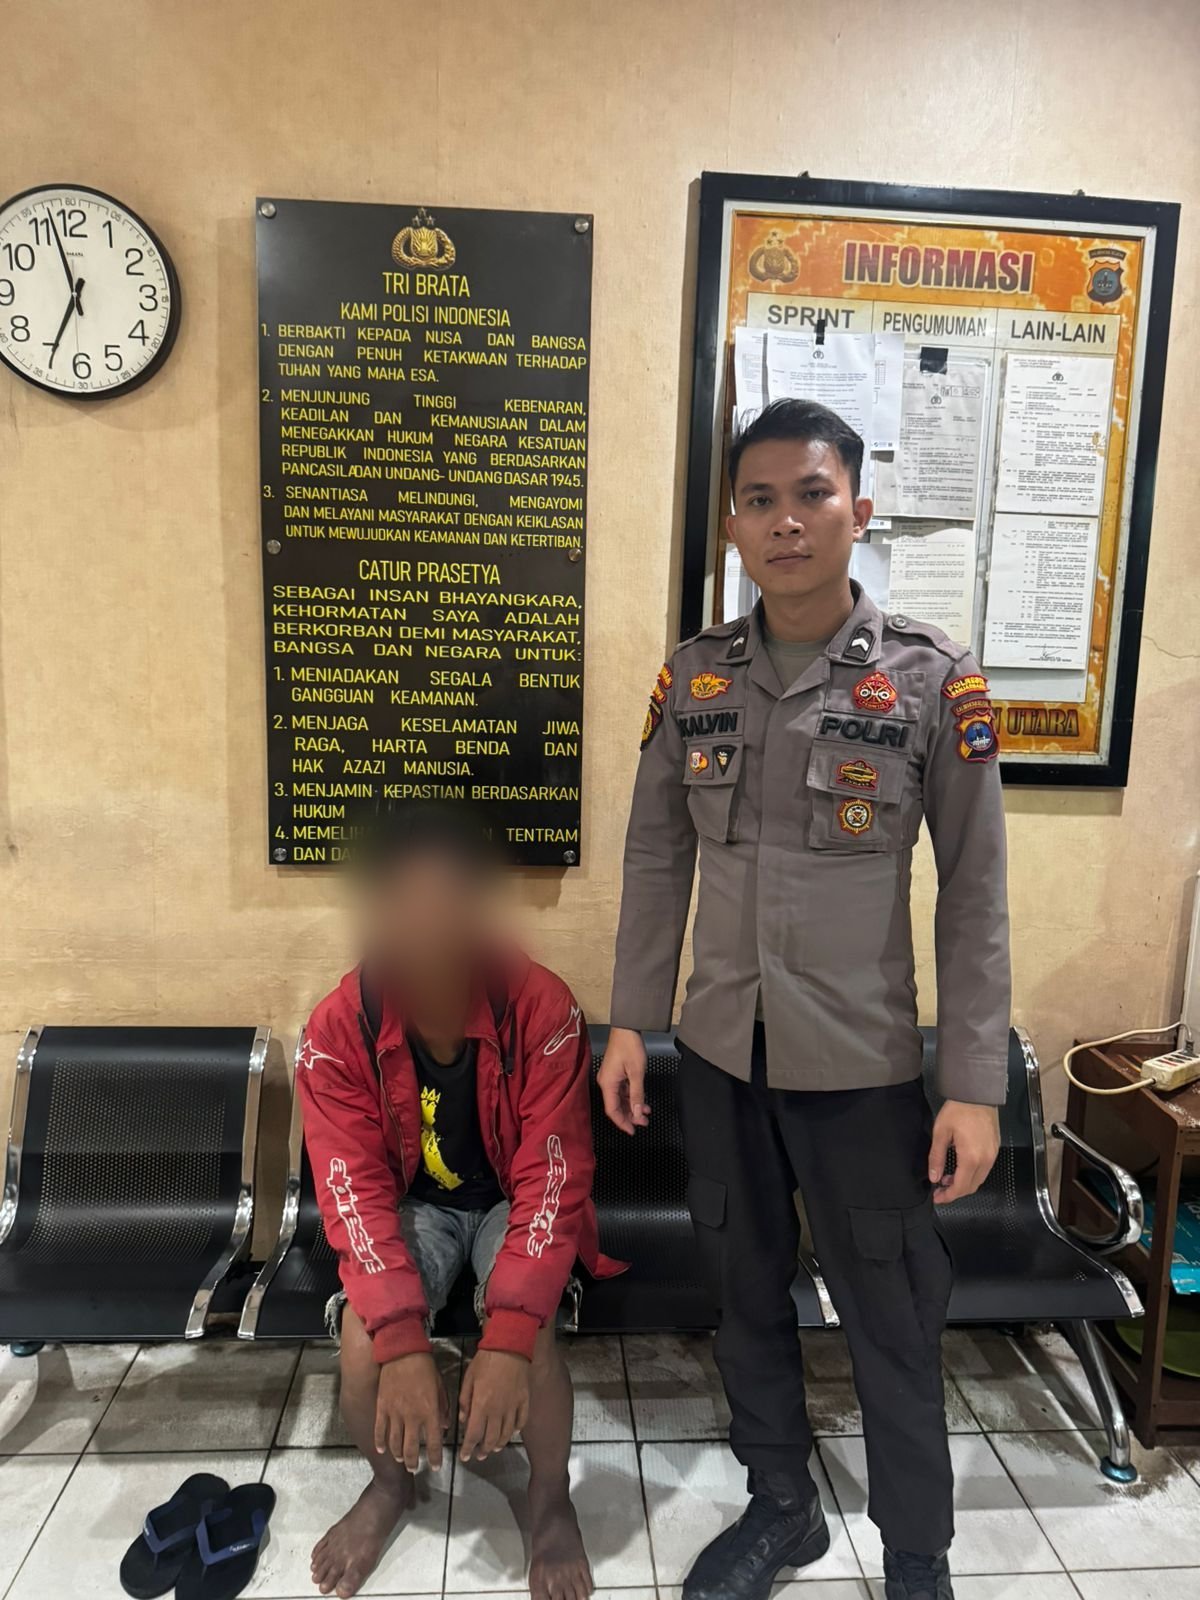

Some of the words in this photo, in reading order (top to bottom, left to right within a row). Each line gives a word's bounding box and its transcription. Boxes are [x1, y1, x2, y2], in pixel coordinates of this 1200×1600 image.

[28, 216, 51, 246] 11
[56, 208, 88, 238] 12
[102, 220, 113, 248] 1
[2, 242, 35, 271] 10
[125, 248, 145, 276] 2
[843, 240, 1035, 294] INFORMASI
[0, 278, 15, 306] 9
[382, 271, 410, 295] TRI
[416, 273, 471, 298] BRATA
[138, 284, 158, 312] 3
[341, 302, 378, 321] KAMI
[382, 303, 429, 323] POLISI
[434, 306, 511, 327] INDONESIA
[767, 304, 855, 329] SPRINT
[883, 312, 987, 337] PENGUMUMAN
[10, 315, 30, 342] 8
[127, 319, 150, 346] 4
[261, 323, 271, 337] 1.
[278, 324, 346, 340] BERBAKTI
[357, 327, 412, 342] KEPADA
[425, 330, 463, 345] NUSA
[487, 332, 515, 347] DAN
[531, 334, 586, 351] BANGSA
[1010, 319, 1106, 343] LAIN-LAIN
[42, 341, 60, 369] 7
[72, 352, 92, 379] 6
[104, 344, 123, 371] 5
[278, 343, 334, 358] DENGAN
[357, 346, 402, 362] PENUH
[423, 349, 508, 366] KETAKWAAN
[516, 354, 586, 369] TERHADAP
[278, 362, 321, 377] TUHAN
[326, 364, 361, 379] YANG
[368, 367, 405, 380] MAHA
[410, 368, 439, 383] ESA.
[262, 389, 273, 402] 2.
[280, 388, 370, 406] MENJUNJUNG
[413, 394, 457, 409] TINGGI
[504, 399, 586, 416] KEBENARAN,
[281, 407, 349, 423] KEADILAN
[374, 411, 402, 425] DAN
[431, 413, 528, 431] KEMANUSIAAN
[539, 418, 586, 433] DALAM
[281, 425, 374, 442] MENEGAKKAN
[387, 430, 434, 445] HUKUM
[454, 433, 508, 448] NEGARA
[518, 436, 586, 451] KESATUAN
[281, 443, 347, 459] REPUBLIK
[363, 447, 434, 463] INDONESIA
[442, 451, 477, 465] YANG
[490, 452, 586, 470] BERDASARKAN
[550, 473, 584, 488] 1945.
[263, 484, 275, 498] 3.
[285, 485, 369, 502] SENANTIASA
[398, 490, 479, 508] MELINDUNGI,
[509, 495, 583, 511] MENGAYOMI
[284, 504, 310, 519] DAN
[313, 506, 375, 521] MELAYANI
[379, 510, 460, 524] MASYARAKAT
[464, 512, 513, 527] DENGAN
[516, 514, 584, 530] KEIKLASAN
[285, 524, 326, 538] UNTUK
[328, 526, 411, 542] MEWUJUDKAN
[414, 529, 480, 545] KEAMANAN
[483, 532, 507, 546] DAN
[510, 533, 584, 549] KETERTIBAN.
[359, 559, 412, 582] CATUR
[417, 561, 501, 585] PRASETYA
[273, 585, 355, 601] SEBAGAI
[369, 588, 429, 603] INSAN
[439, 591, 582, 610] BHAYANGKARA,
[273, 603, 407, 621] KEHORMATAN
[432, 609, 480, 623] SAYA
[505, 612, 579, 625] ADALAH
[273, 622, 392, 638] BERKORBAN
[399, 626, 445, 640] DEMI
[452, 628, 581, 645] MASYARAKAT,
[273, 640, 354, 656] BANGSA
[374, 643, 413, 657] DAN
[425, 645, 502, 660] NEGARA
[515, 647, 581, 662] UNTUK:
[273, 666, 285, 681] 1.
[291, 666, 399, 684] MENIADAKAN
[430, 670, 493, 687] SEGALA
[519, 672, 581, 689] BENTUK
[291, 687, 374, 704] GANGGUAN
[391, 689, 479, 706] KEAMANAN.
[273, 714, 288, 730] 2.
[291, 714, 369, 731] MENJAGA
[401, 717, 517, 734] KESELAMATAN
[542, 720, 580, 736] JIWA
[678, 711, 738, 737] KALVIN
[819, 715, 909, 748] POLRI
[1006, 707, 1080, 737] UTARA
[294, 736, 345, 754] RAGA,
[372, 738, 428, 754] HARTA
[455, 740, 511, 756] BENDA
[545, 742, 577, 756] DAN
[292, 758, 324, 773] HAK
[342, 759, 386, 775] AZAZI
[403, 760, 475, 776] MANUSIA.
[274, 782, 288, 797] 3.
[293, 782, 373, 798] MENJAMIN
[383, 783, 465, 799] KEPASTIAN
[471, 785, 579, 801] BERDASARKAN
[293, 804, 345, 819] HUKUM
[274, 825, 289, 840] 4.
[506, 827, 578, 843] TENTRAM
[293, 846, 326, 861] DAN
